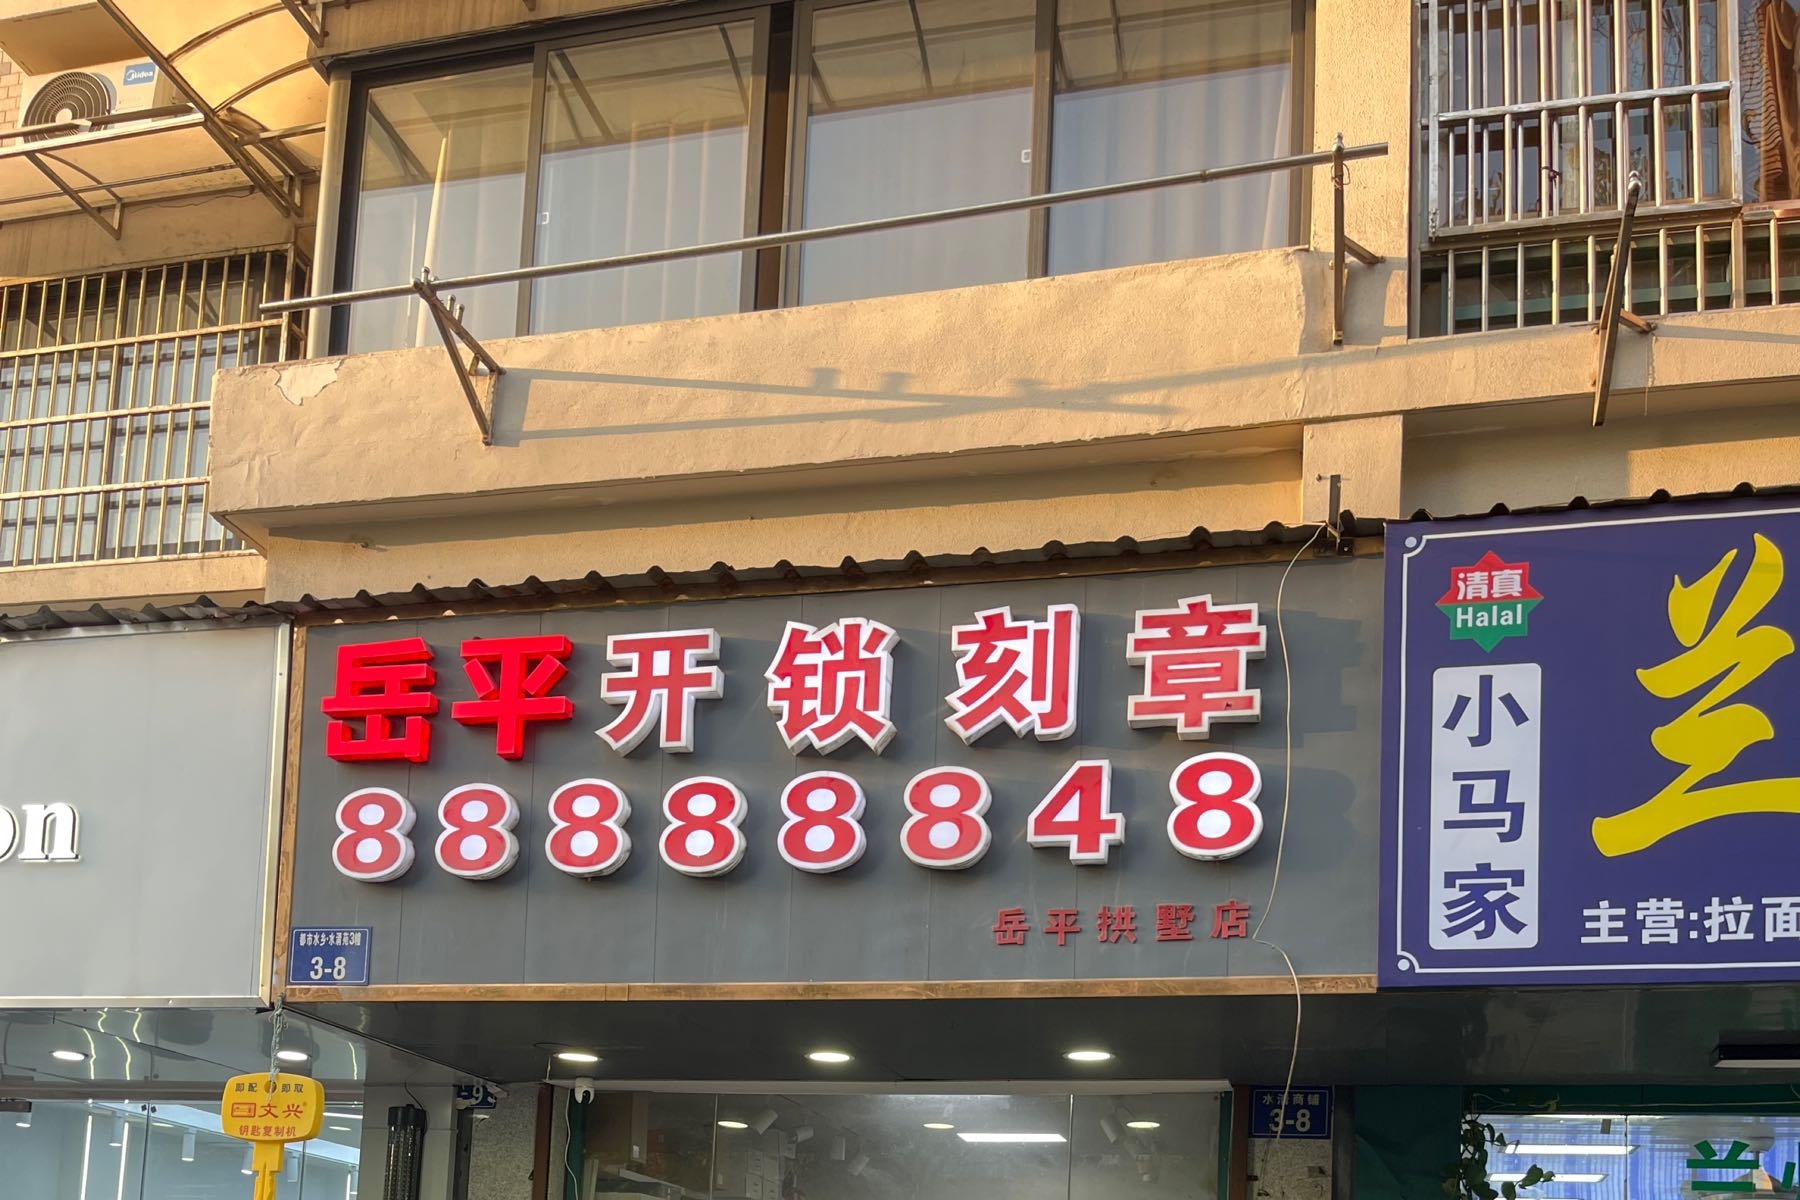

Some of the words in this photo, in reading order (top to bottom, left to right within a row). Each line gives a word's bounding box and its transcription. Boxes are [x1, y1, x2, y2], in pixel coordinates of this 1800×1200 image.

[1456, 569, 1524, 600] 清真
[1456, 604, 1523, 628] Halal
[1591, 533, 1800, 857] 兰
[1441, 674, 1529, 940] 小马家
[992, 901, 1251, 947] 岳平拱墅店
[310, 956, 346, 980] 3-8
[239, 1124, 297, 1137] 钥匙复制机
[1269, 1108, 1311, 1132] 3-8
